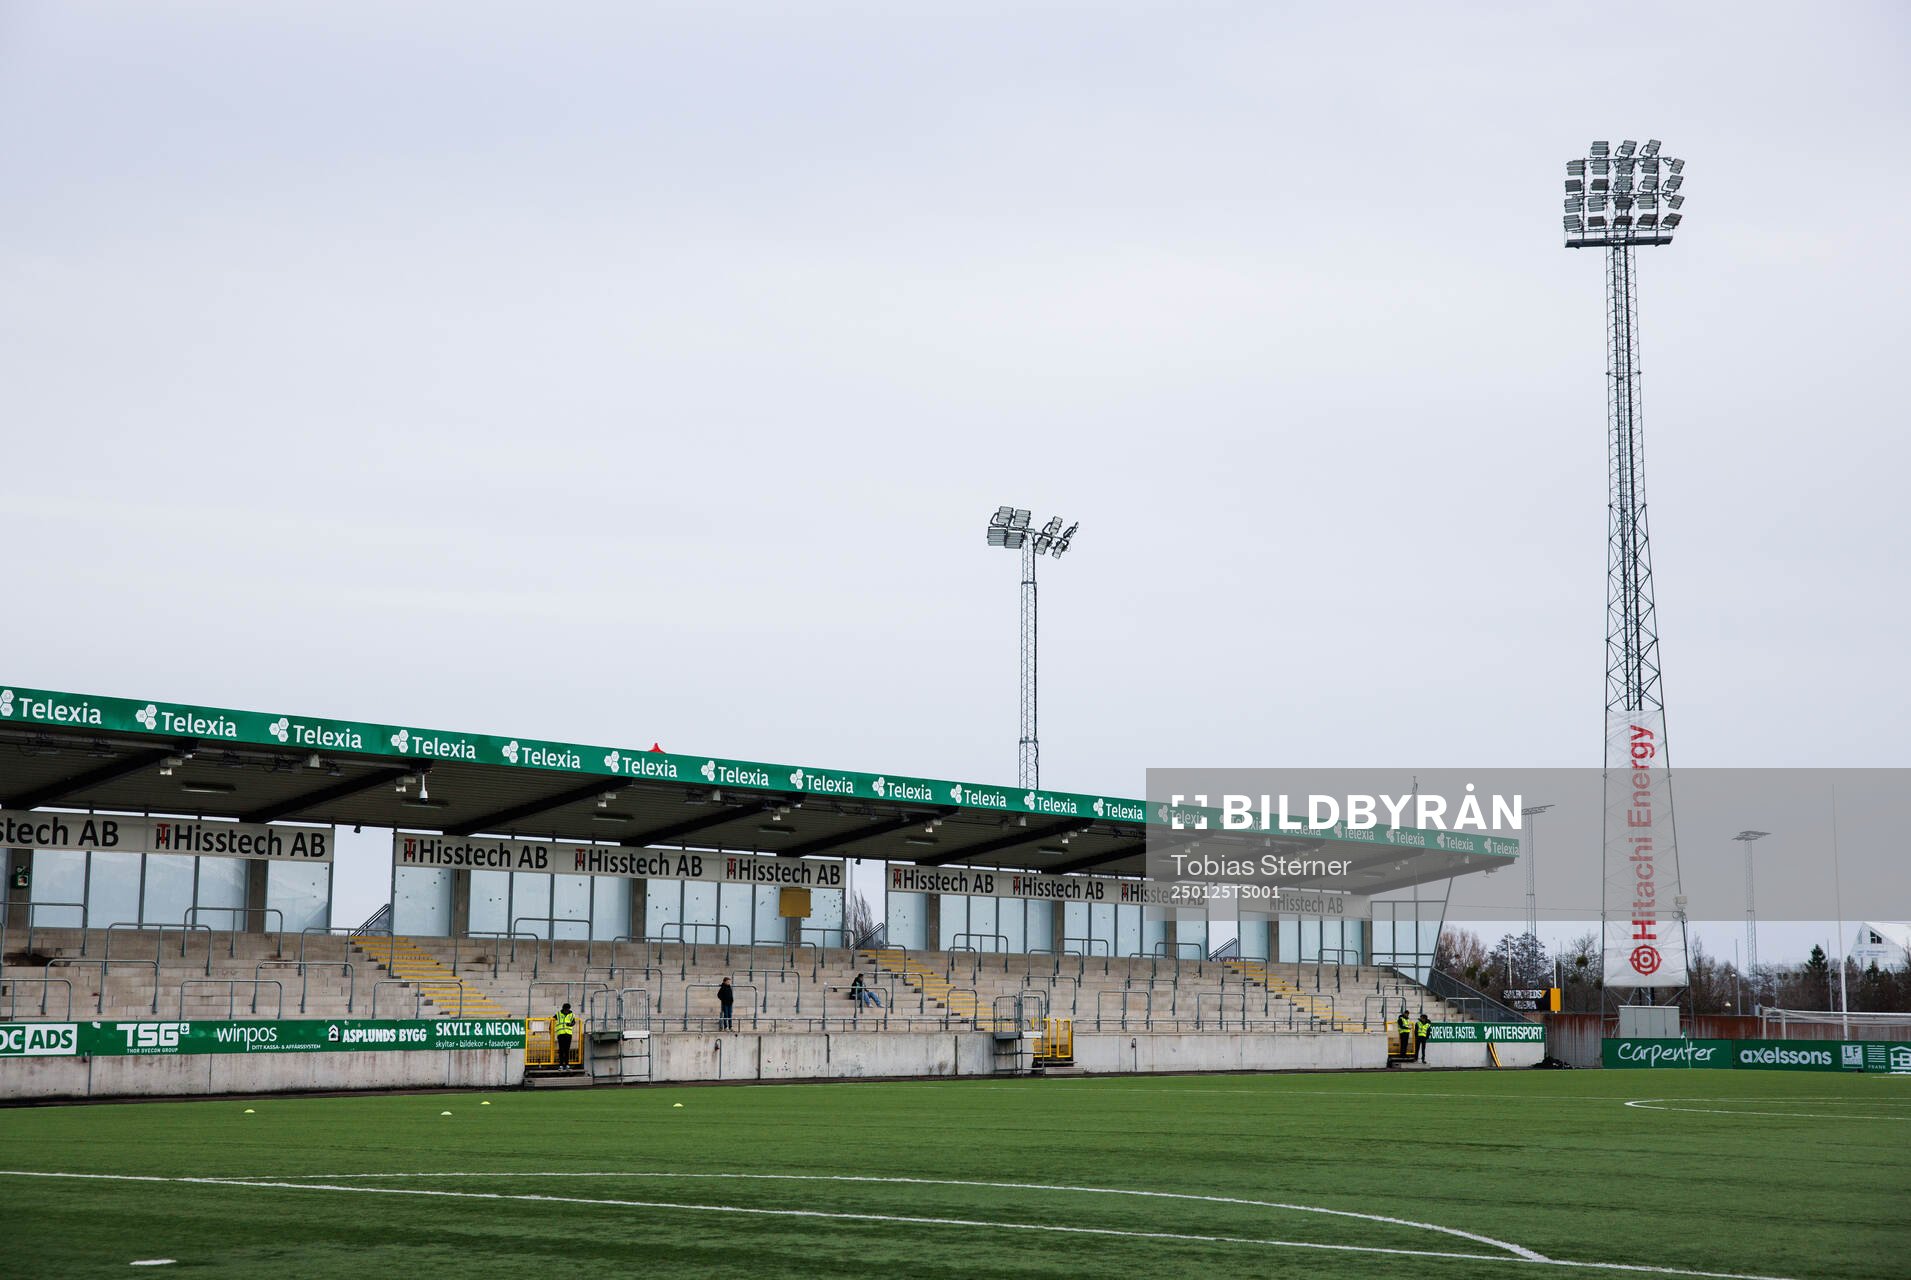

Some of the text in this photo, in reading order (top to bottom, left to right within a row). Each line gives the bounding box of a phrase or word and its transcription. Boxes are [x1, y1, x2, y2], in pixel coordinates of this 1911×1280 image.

[19, 697, 101, 725] Telexia
[162, 711, 237, 737] Telexia
[293, 724, 363, 749] Telexia
[412, 736, 476, 760] Telexia
[521, 746, 581, 769] Telexia
[622, 756, 678, 778] Telexia
[718, 766, 769, 786] Telexia
[806, 774, 854, 794] Telexia
[887, 782, 932, 800] Telexia
[964, 789, 1007, 807] Telexia
[1037, 796, 1077, 814] Telexia
[1106, 803, 1143, 820] Telexia
[78, 819, 118, 847] AB
[175, 823, 326, 857] Hisstech AB
[1396, 831, 1425, 846] Telexia
[1627, 724, 1657, 940] Hitachi Energy
[419, 839, 548, 869] Hisstech AB
[1445, 836, 1474, 851] Telexia
[1492, 841, 1520, 856] Telexia
[588, 848, 703, 877] Hisstech AB
[738, 858, 841, 885] Hisstech AB
[904, 868, 994, 894] Hisstech AB
[1022, 877, 1104, 900] Hisstech AB
[1277, 893, 1344, 914] Hisstech AB
[28, 1029, 73, 1049] ADS
[116, 1023, 179, 1047] TSG
[216, 1023, 277, 1051] winpos
[342, 1028, 427, 1043] ASPLUNDS BYGG
[435, 1022, 471, 1036] SKYLT
[474, 1022, 483, 1036] &
[1455, 1026, 1477, 1039] FASTER.
[1492, 1026, 1543, 1039] INTERSPORT
[435, 1040, 455, 1049] skyltar
[1618, 1041, 1716, 1067] Carpenter
[1740, 1046, 1832, 1065] axelssons
